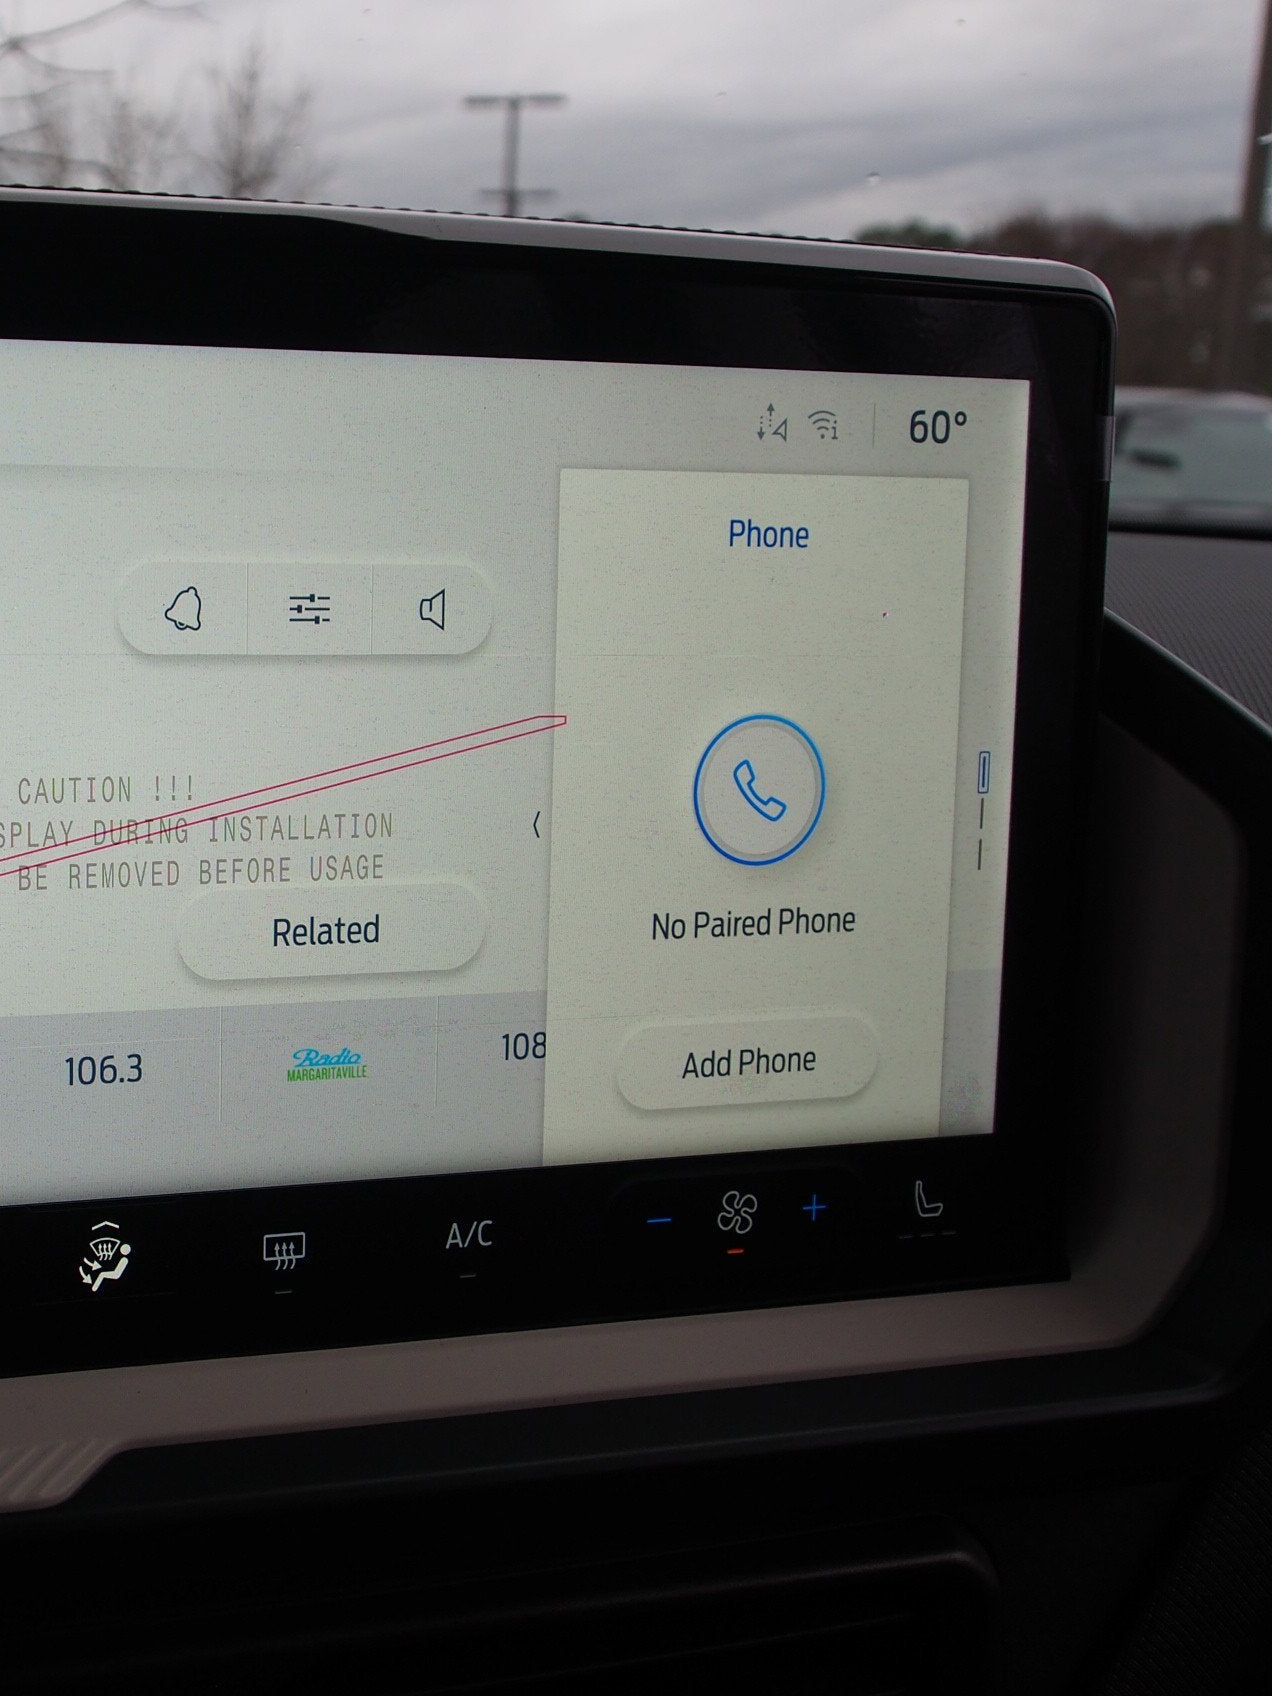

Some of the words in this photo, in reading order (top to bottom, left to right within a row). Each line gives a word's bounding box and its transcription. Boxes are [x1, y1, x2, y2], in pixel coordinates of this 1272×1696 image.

[909, 409, 968, 445] 60°
[729, 518, 810, 549] Phone
[18, 776, 132, 805] CAUTION
[93, 818, 189, 846] DURING
[209, 813, 393, 842] INSTALLATION
[18, 864, 49, 891] BE
[69, 860, 181, 889] REMOVED
[199, 856, 292, 885] BEFORE
[309, 854, 385, 882] USAGE
[272, 914, 381, 948] Related
[651, 913, 686, 940] No
[693, 908, 772, 938] Paired
[778, 906, 856, 936] Phone
[292, 1047, 362, 1067] Radio
[502, 1031, 546, 1060] 108
[63, 1053, 144, 1087] 106.3
[287, 1065, 368, 1082] MARGARITAVILLE
[682, 1049, 732, 1079] Add
[738, 1046, 817, 1075] Phone
[445, 1220, 493, 1249] A/C
